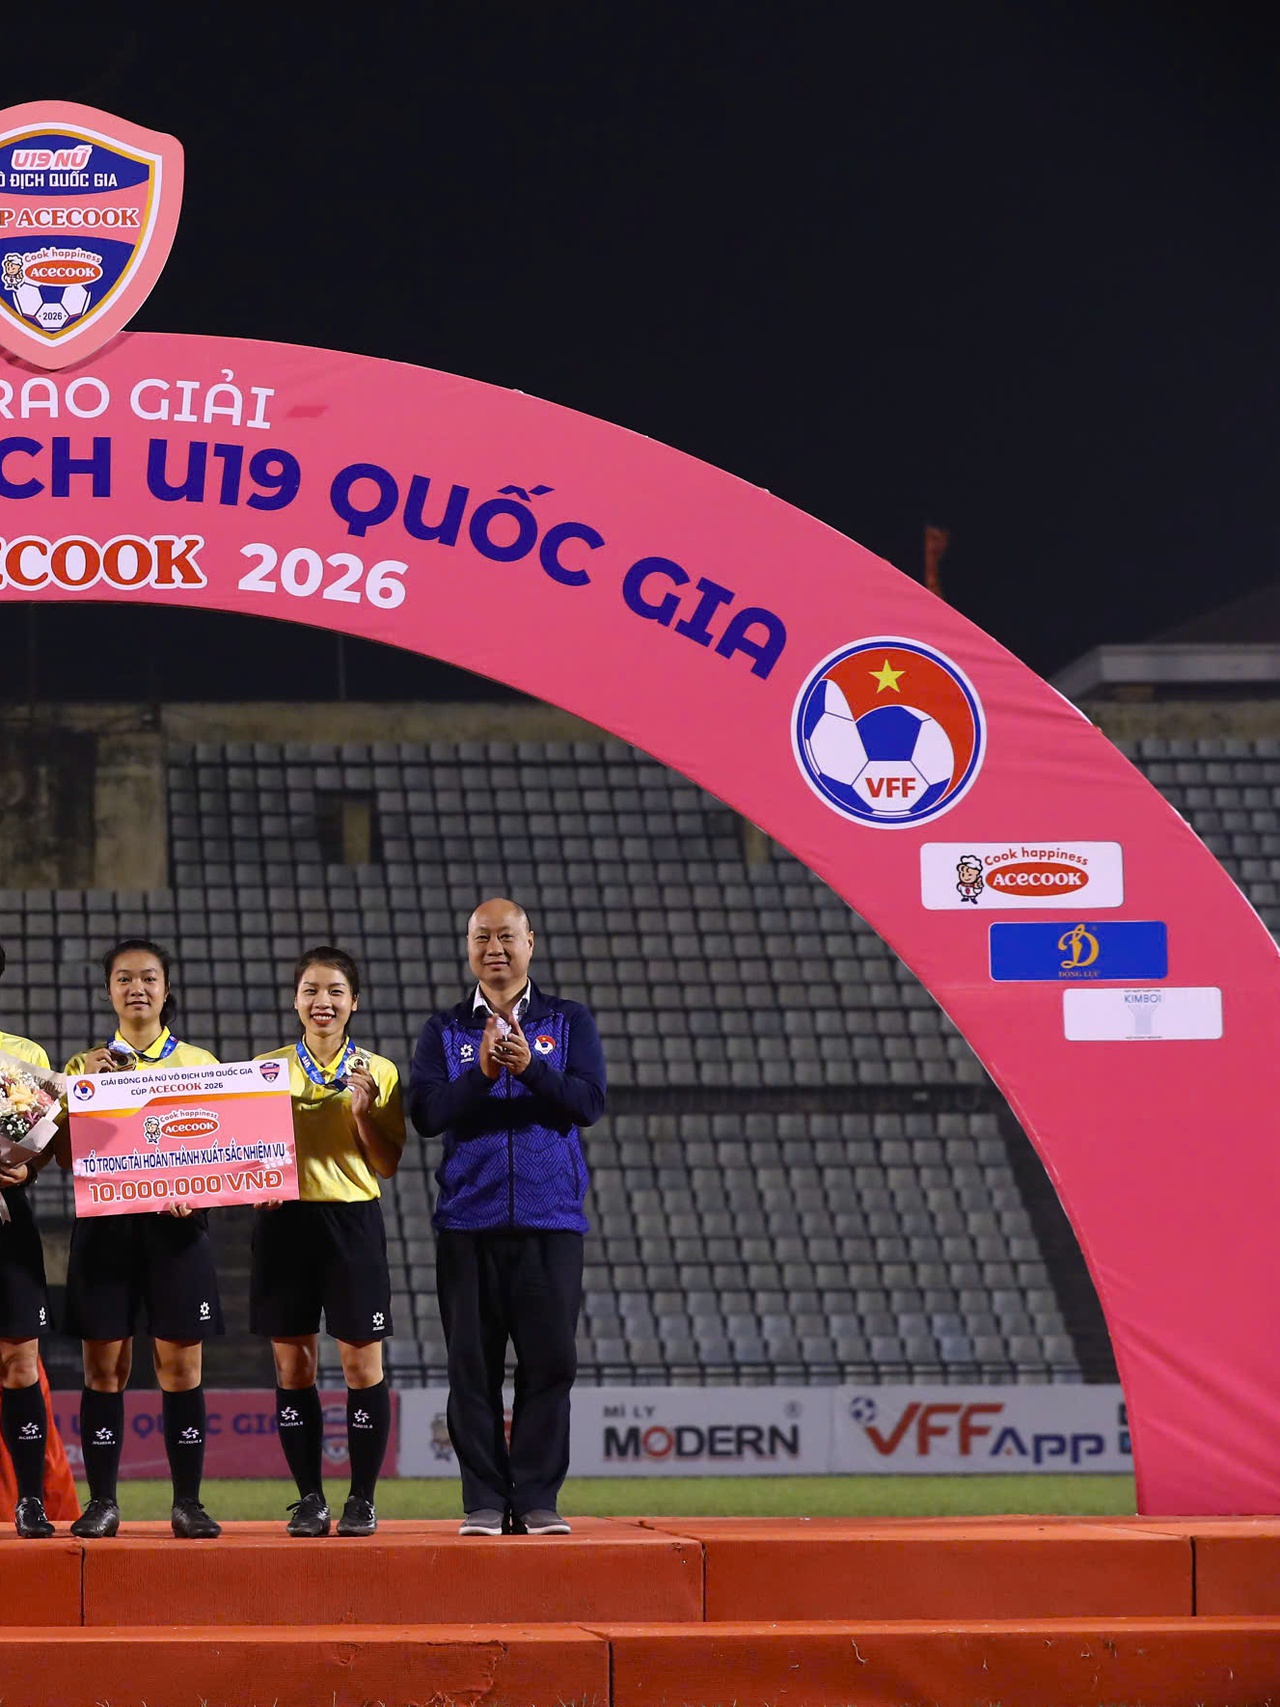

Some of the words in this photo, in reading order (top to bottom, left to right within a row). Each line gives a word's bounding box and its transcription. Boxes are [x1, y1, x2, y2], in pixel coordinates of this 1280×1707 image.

[13, 151, 53, 168] U19
[53, 145, 93, 168] NỮ
[9, 173, 45, 189] ĐỊCH
[49, 170, 89, 188] QUỐC
[94, 172, 118, 187] GIA
[19, 208, 140, 227] ACECOOK
[24, 249, 50, 263] Cook
[51, 248, 102, 264] happiness
[129, 368, 275, 430] GIẢI
[146, 437, 302, 511] U19
[329, 463, 606, 587] QUỐC
[621, 556, 788, 681] GIA
[237, 542, 409, 610] 2026
[865, 777, 917, 798] VFF
[984, 848, 1018, 866] Cook
[1021, 846, 1089, 866] happiness
[1124, 994, 1162, 1004] KIMBOI
[100, 1078, 117, 1087] GIẢI
[117, 1076, 141, 1086] BÓNG
[142, 1074, 154, 1084] ĐÁ
[168, 1072, 180, 1082] VÔ
[181, 1071, 200, 1081] ĐỊCH
[201, 1070, 214, 1078] U19
[215, 1067, 238, 1078] QUỐC
[239, 1067, 253, 1076] GIA
[131, 1086, 147, 1096] CÚP
[148, 1082, 202, 1094] ACECOOK
[204, 1082, 224, 1090] 2026
[160, 1111, 179, 1123] Cook
[179, 1109, 218, 1119] happiness
[83, 1150, 96, 1173] TỔ
[96, 1157, 128, 1174] TRỌNG
[127, 1148, 142, 1168] TÀI
[143, 1146, 169, 1168] HOÀN
[169, 1144, 200, 1166] THÀNH
[200, 1140, 224, 1162] XUẤT
[224, 1137, 242, 1161] SẮC
[243, 1141, 272, 1162] NHIỆM
[272, 1143, 286, 1160] VỤ
[89, 1176, 222, 1203] 10.000.000
[225, 1169, 284, 1192] VNĐ
[632, 1405, 657, 1418] LY
[602, 1424, 801, 1460] MODERN
